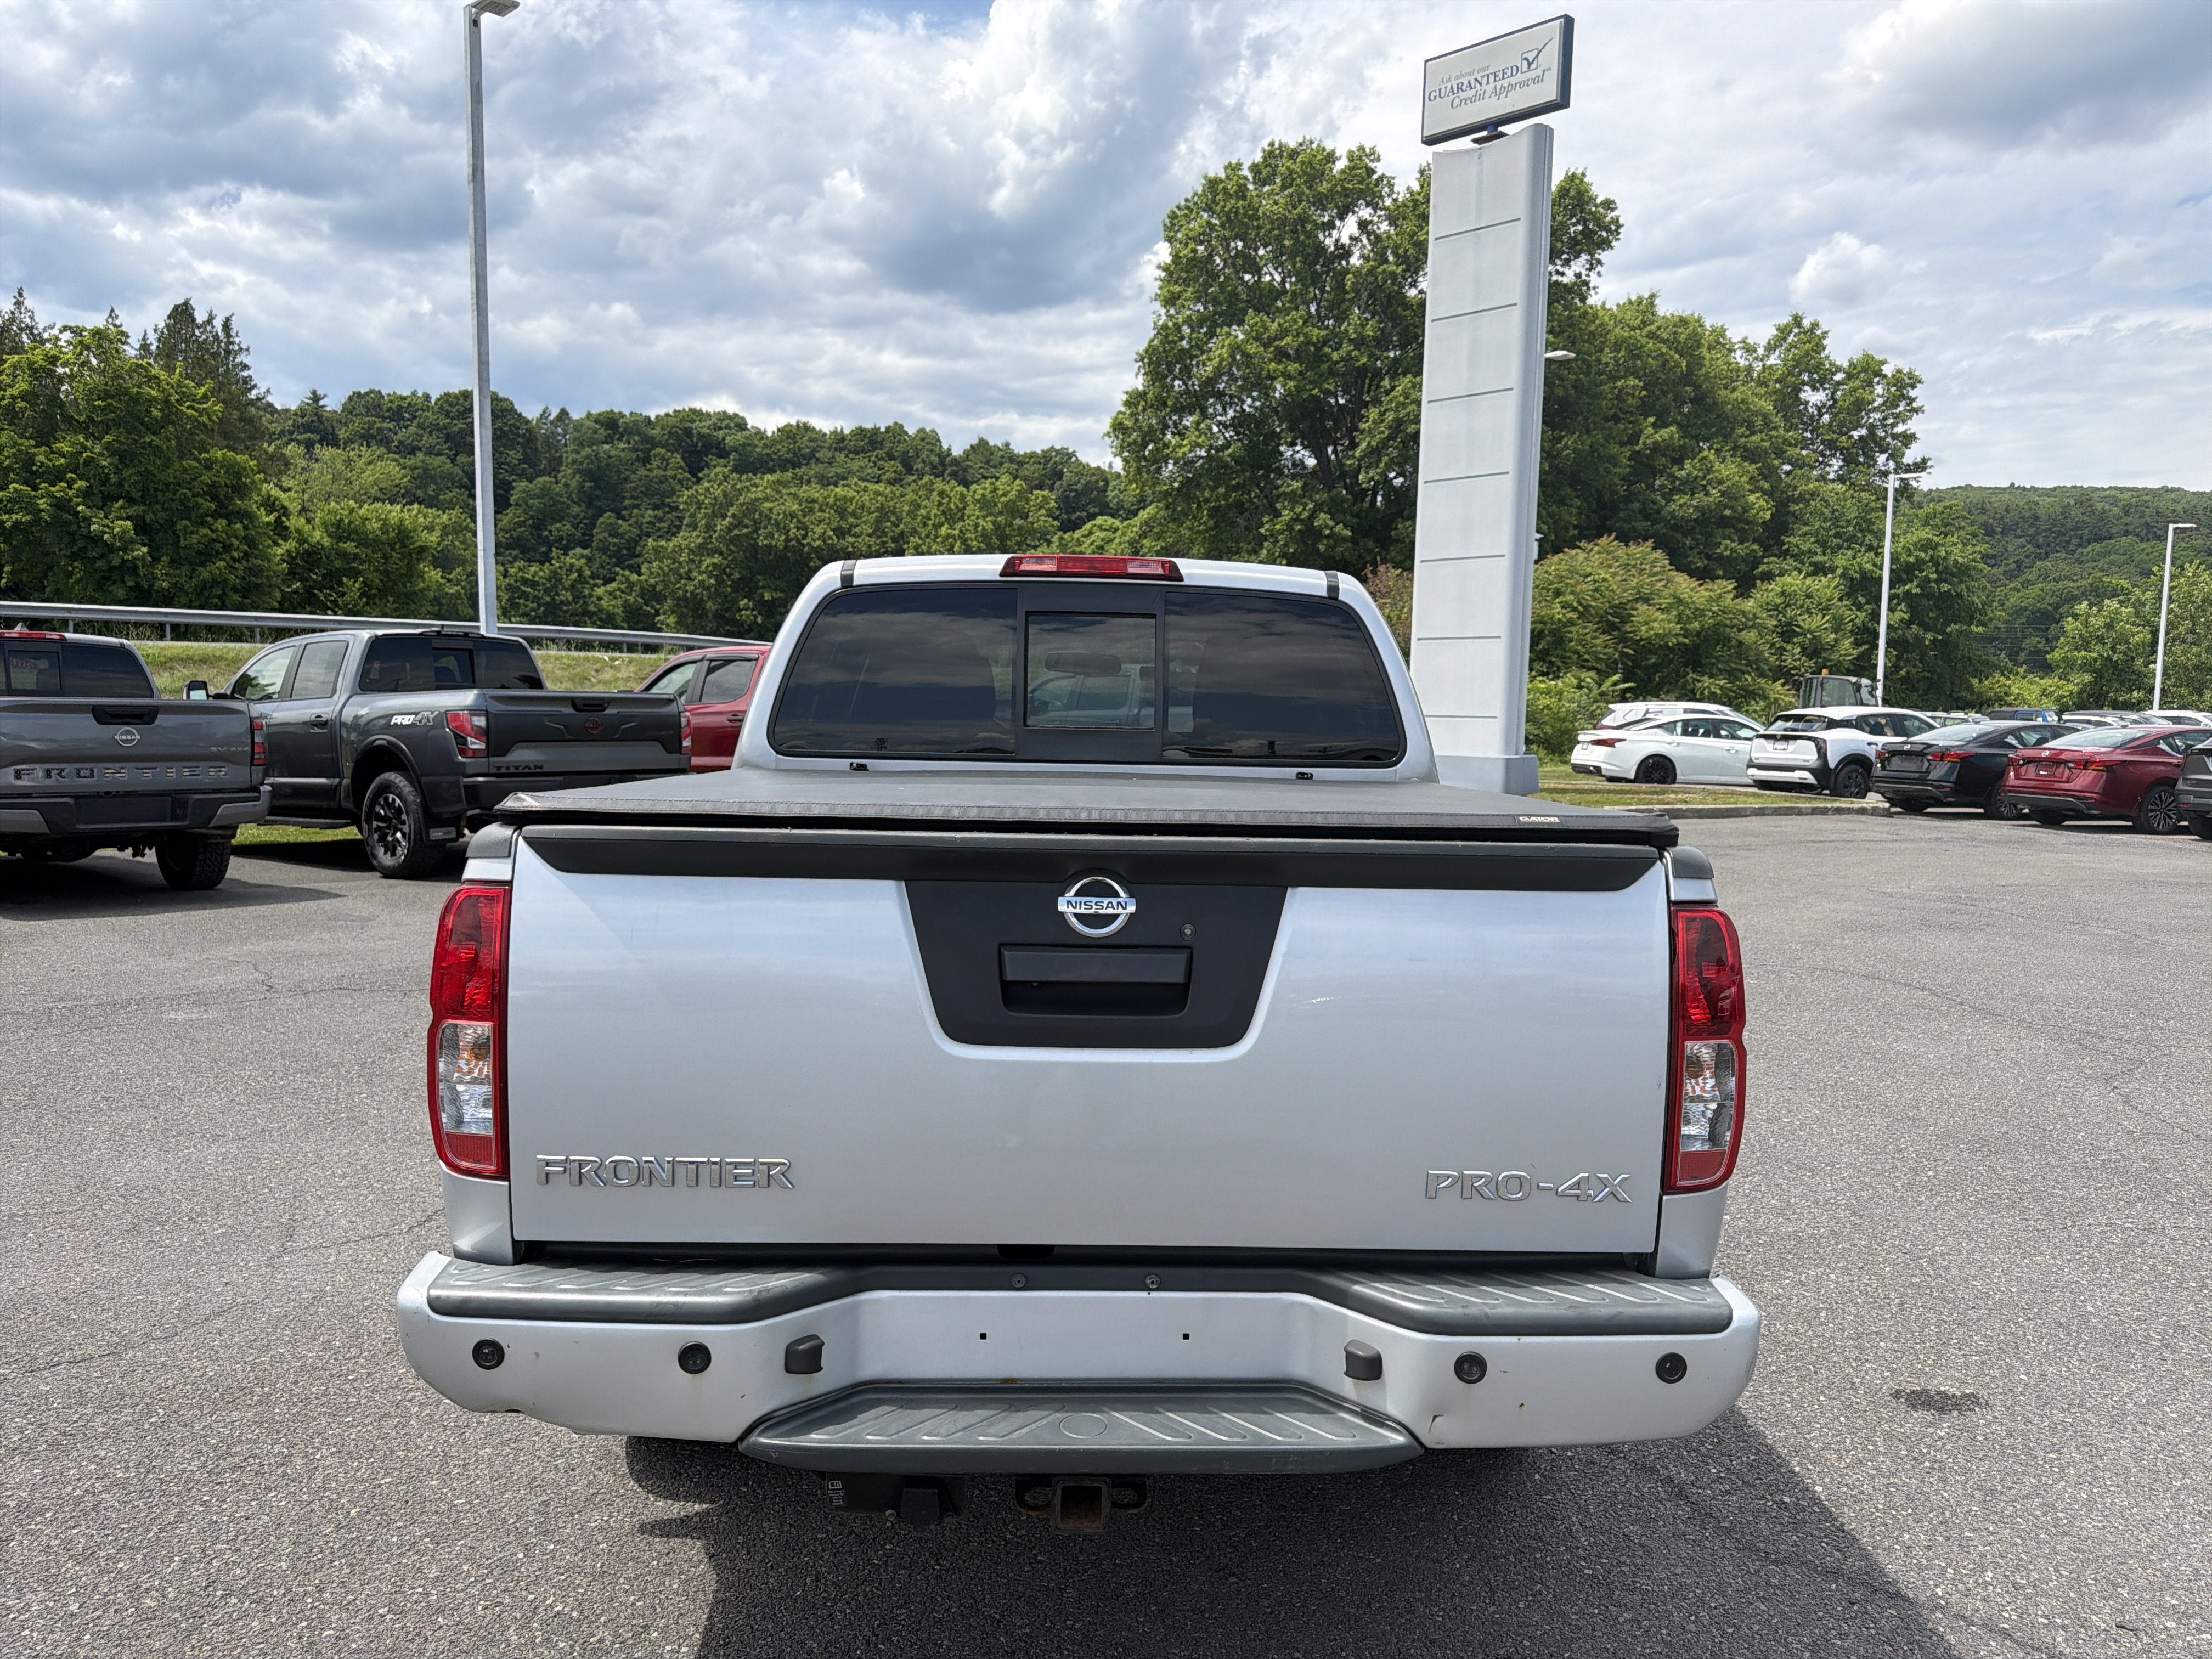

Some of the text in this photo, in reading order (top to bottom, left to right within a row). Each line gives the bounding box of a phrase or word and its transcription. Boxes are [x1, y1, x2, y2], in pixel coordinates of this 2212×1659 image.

[1428, 65, 1519, 102] GUARANTEED
[1438, 65, 1491, 86] Ask about our
[1451, 88, 1486, 109] Credit
[14, 766, 229, 781] FRONTIER
[1066, 900, 1127, 911] NISSAN
[536, 1155, 794, 1188] FRONTIER
[1426, 1170, 1633, 1203] PRO-4X
